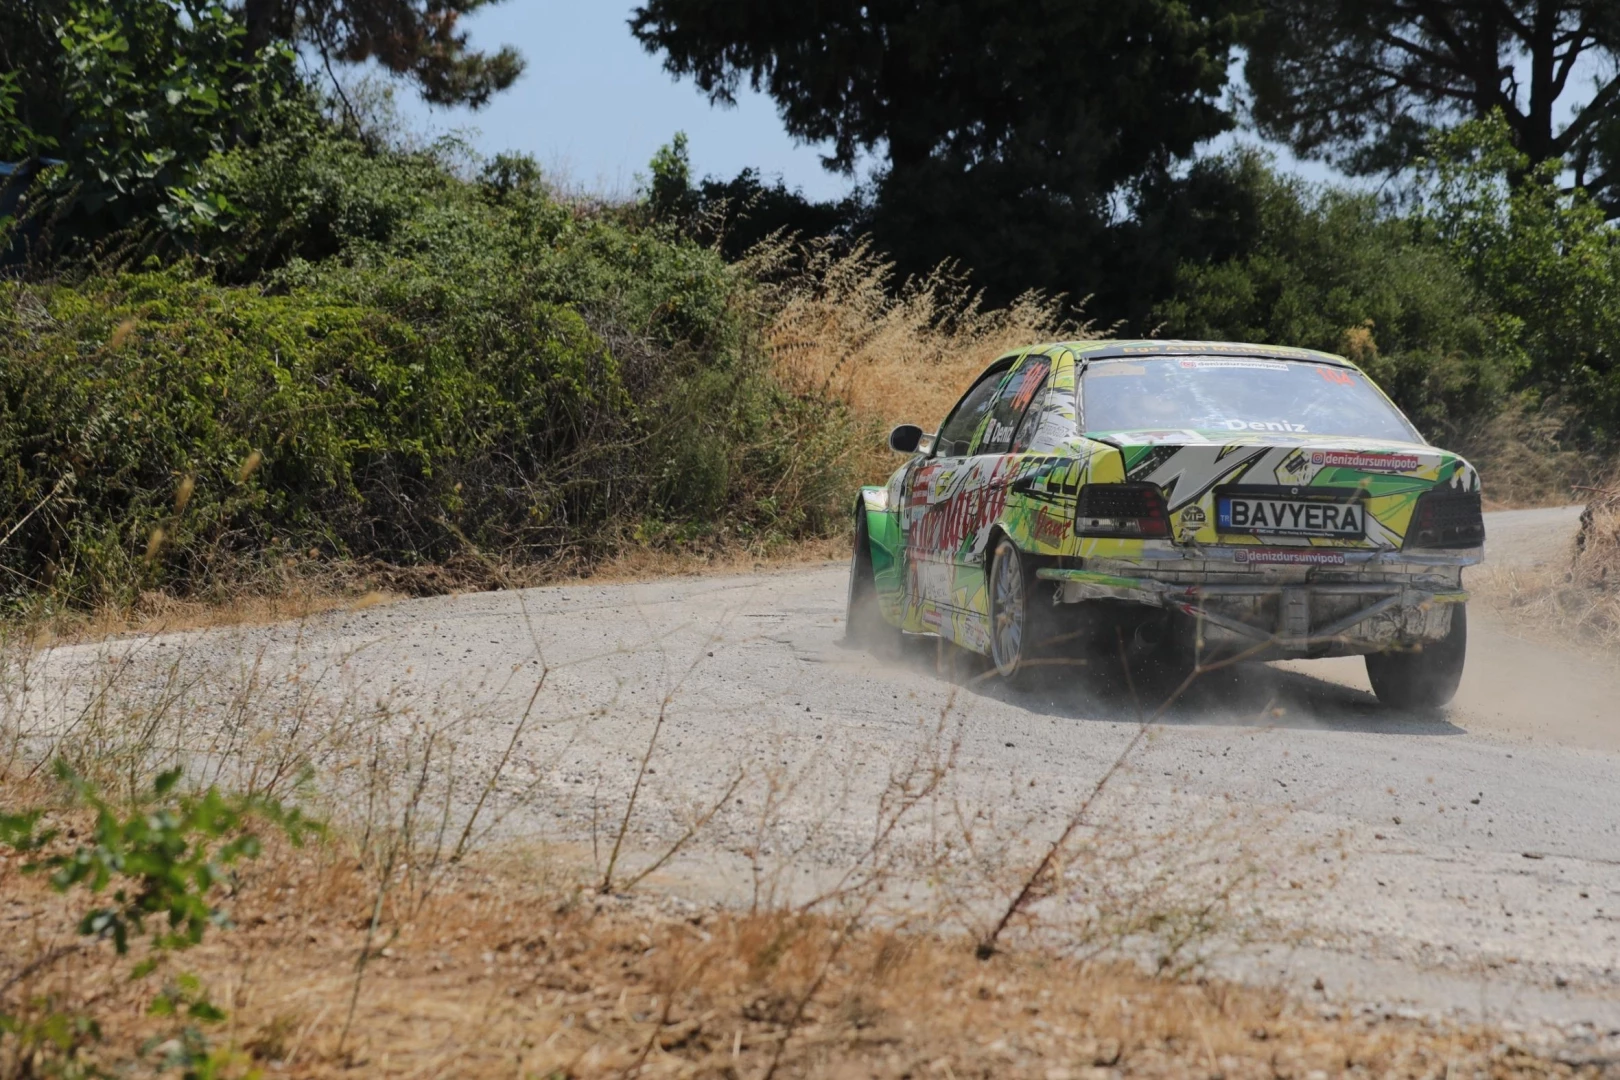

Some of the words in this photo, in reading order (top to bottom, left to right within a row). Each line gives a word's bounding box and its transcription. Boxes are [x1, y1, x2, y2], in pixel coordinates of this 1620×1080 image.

[1316, 367, 1356, 387] 104
[991, 420, 1014, 443] Deniz
[1224, 419, 1309, 433] Deniz
[1325, 453, 1418, 470] denizdursunvipoto
[1035, 505, 1072, 540] Jant
[1220, 514, 1230, 522] TR
[1231, 500, 1359, 531] BAVYERA
[1249, 551, 1344, 564] denizdursunvipoto
